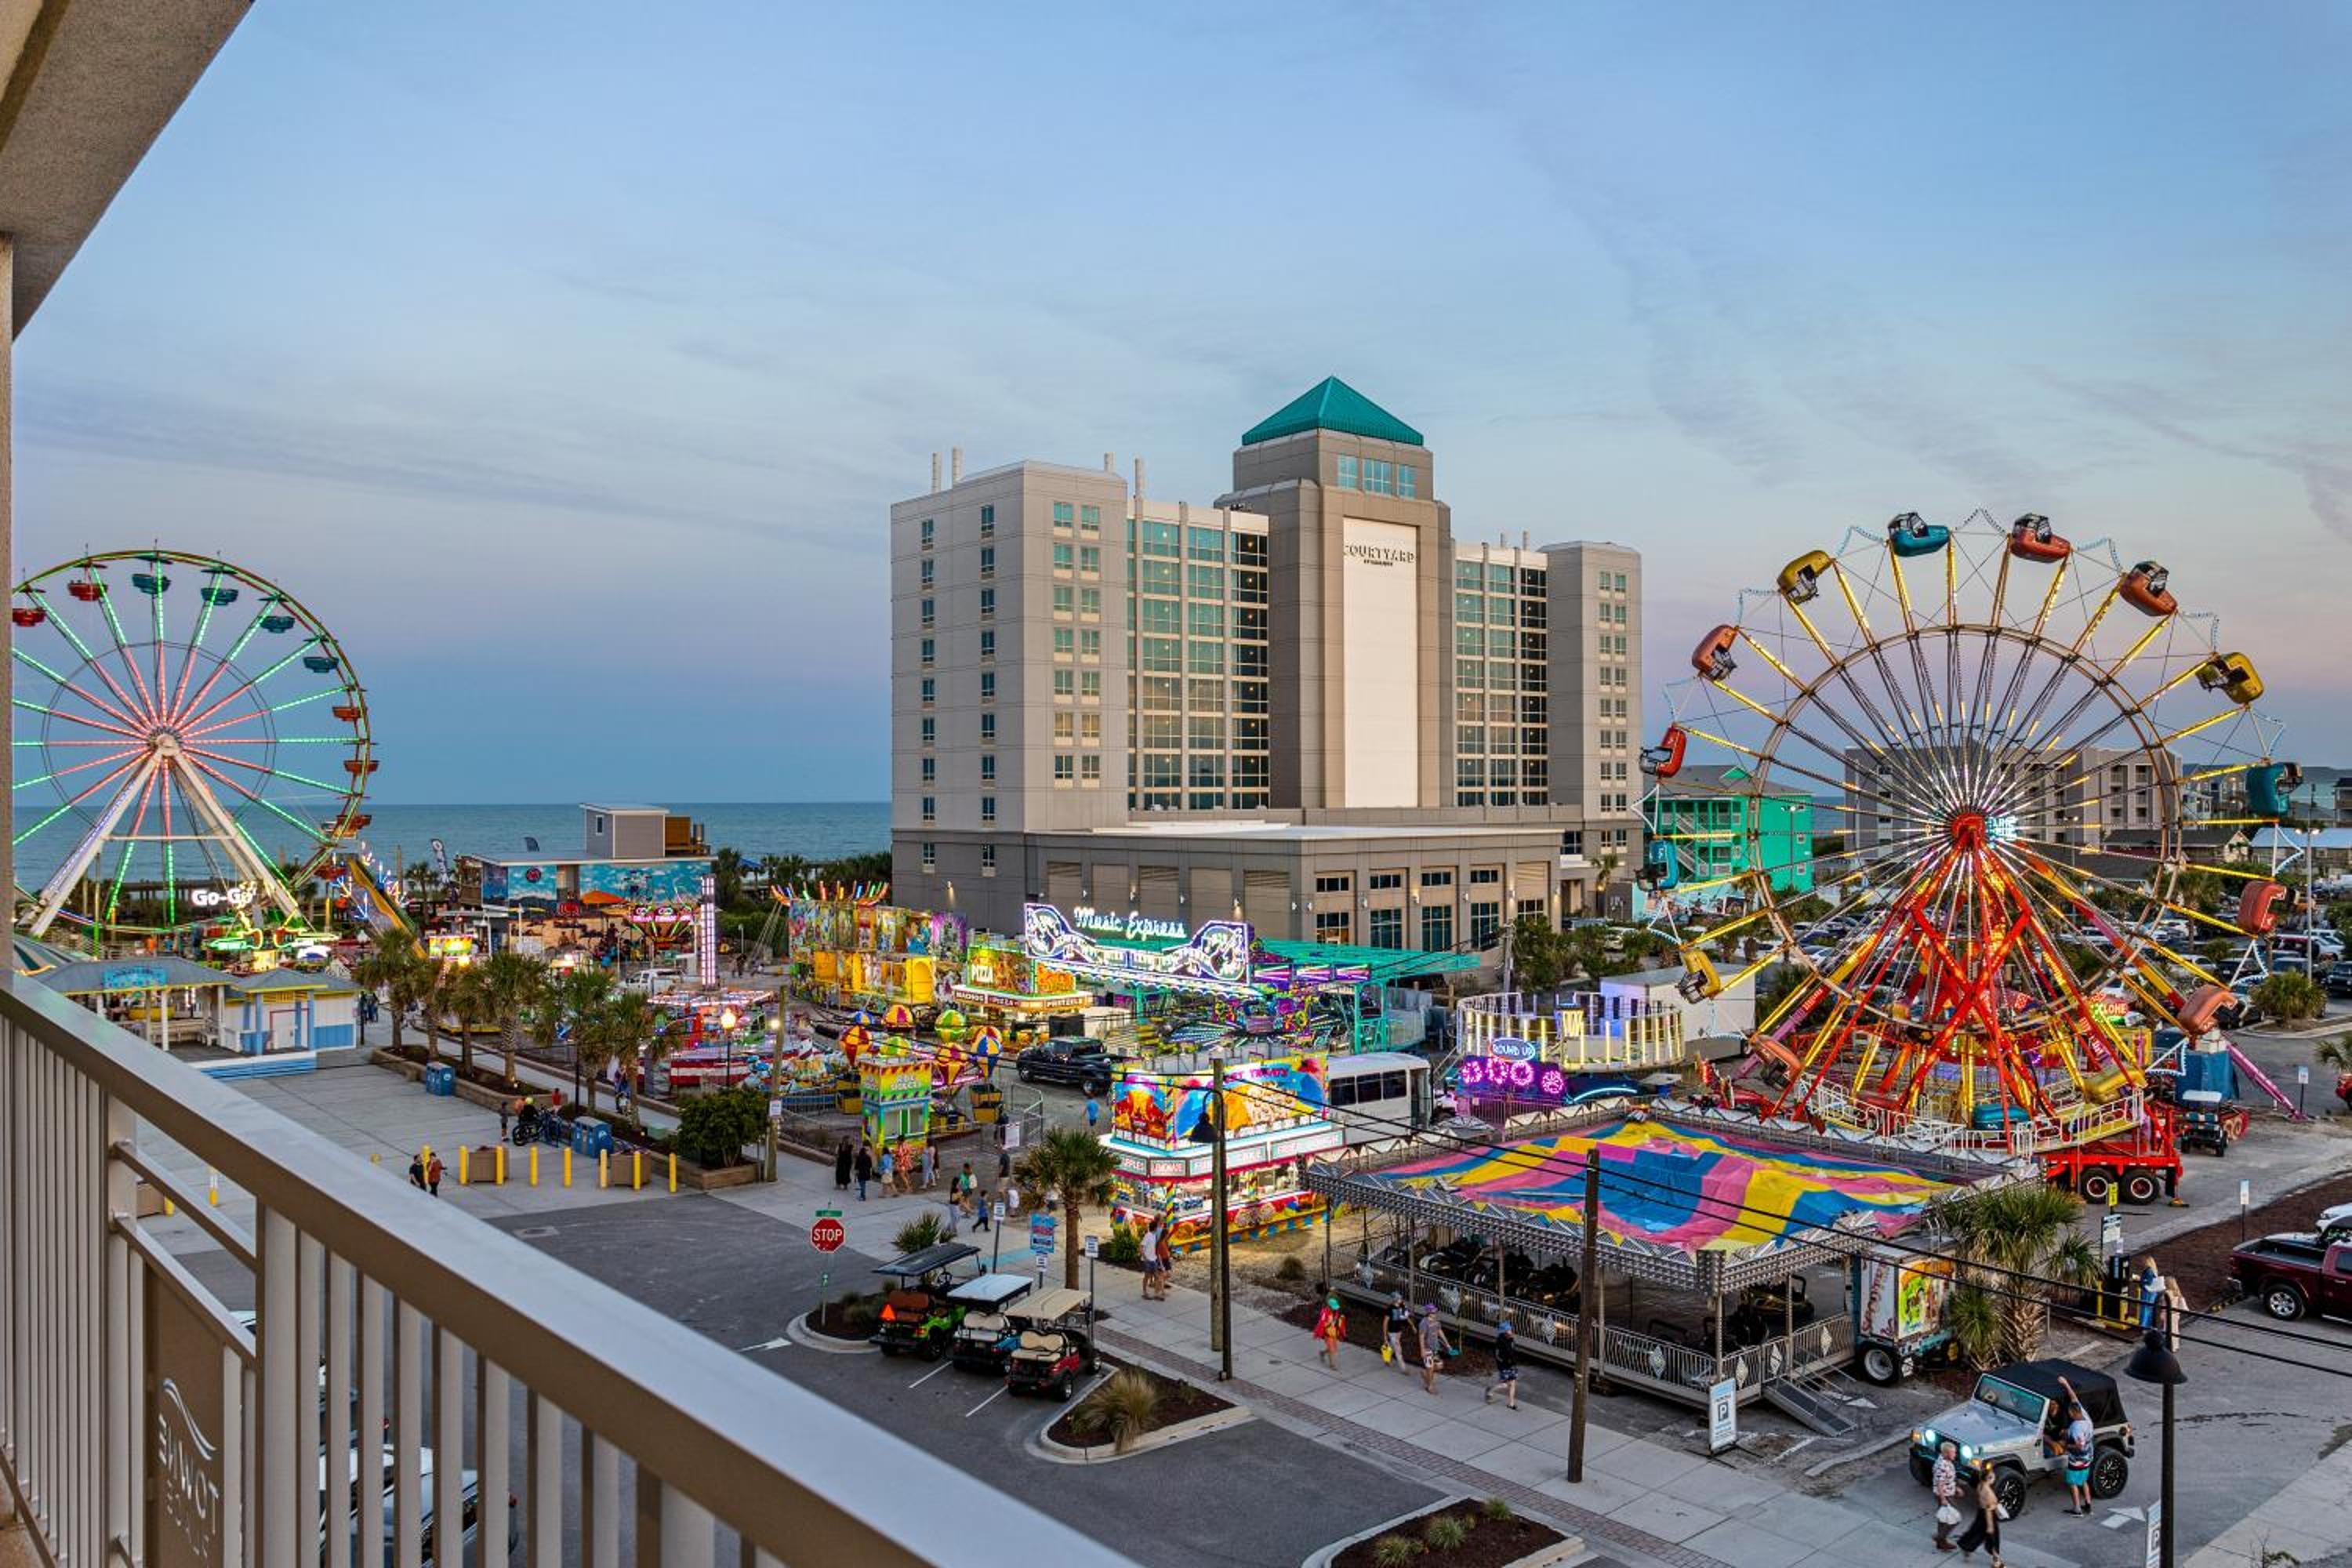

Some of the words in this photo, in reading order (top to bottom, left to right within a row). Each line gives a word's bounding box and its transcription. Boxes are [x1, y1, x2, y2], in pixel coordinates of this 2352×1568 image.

[1073, 906, 1123, 931] Music
[1125, 911, 1186, 941] Express
[971, 964, 993, 983] PIZZA
[814, 1229, 843, 1242] STOP
